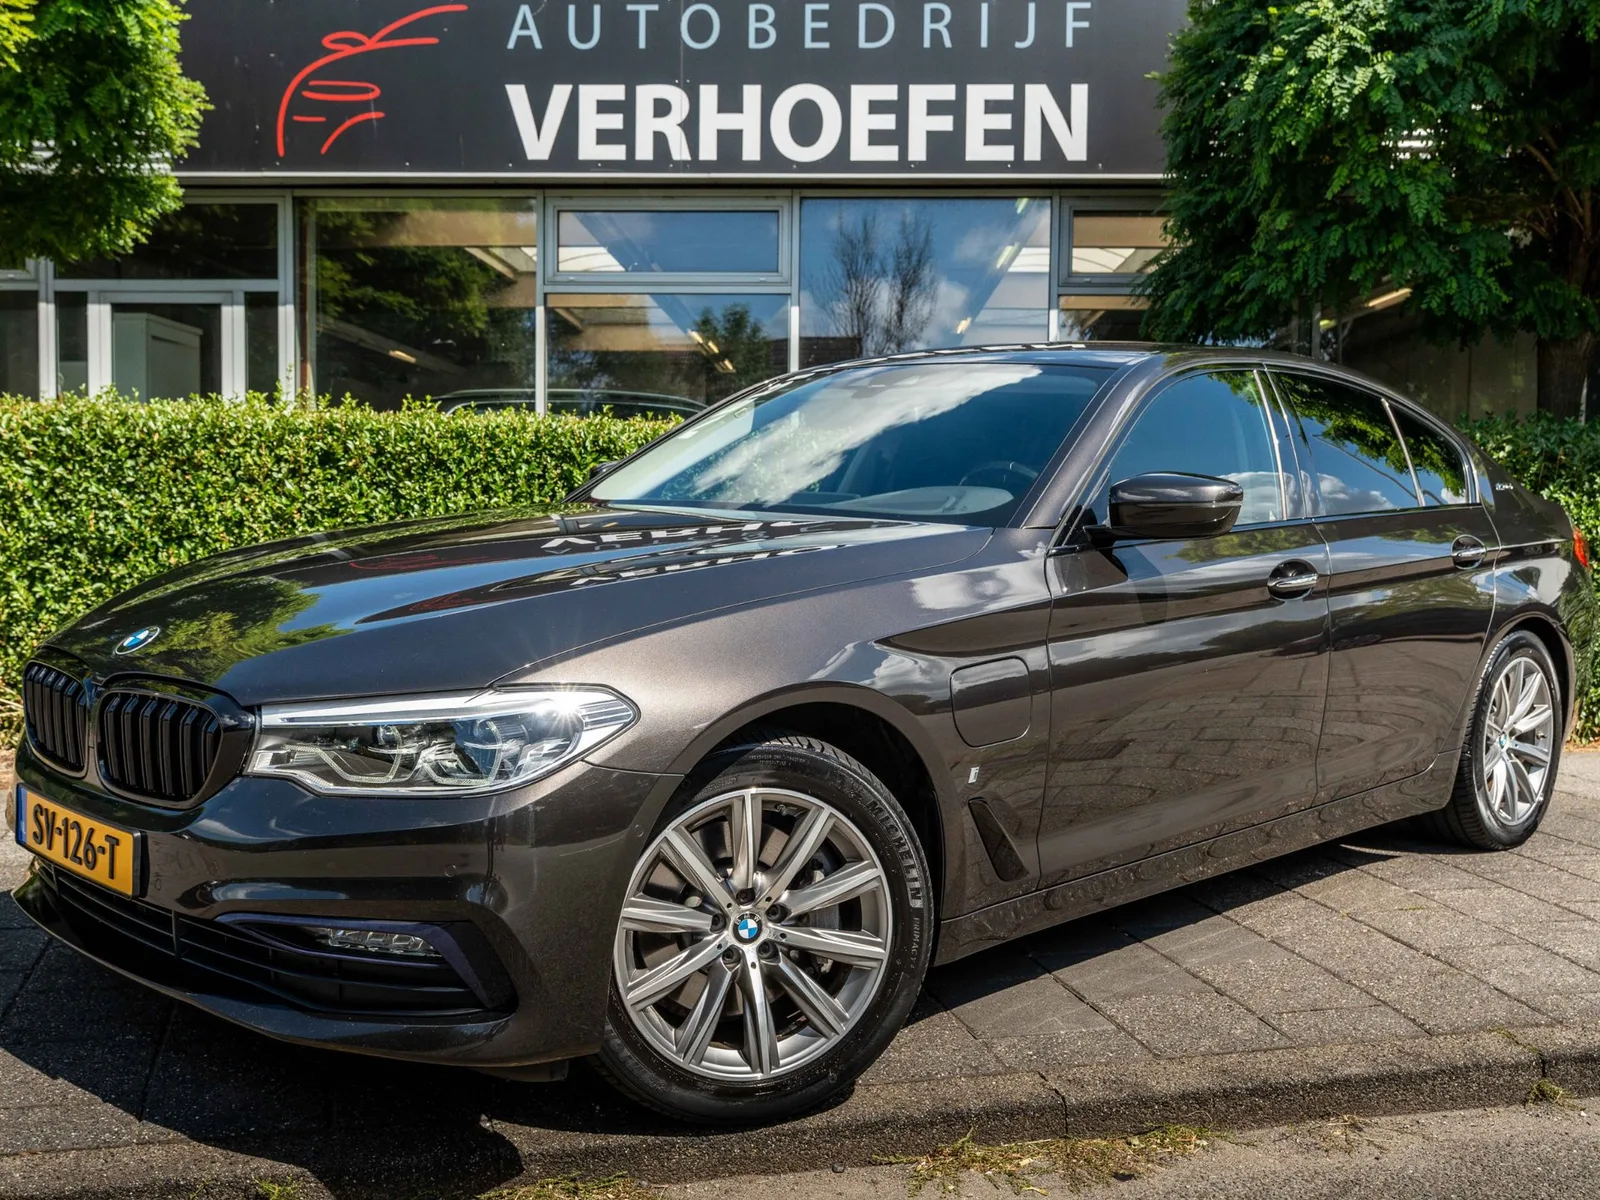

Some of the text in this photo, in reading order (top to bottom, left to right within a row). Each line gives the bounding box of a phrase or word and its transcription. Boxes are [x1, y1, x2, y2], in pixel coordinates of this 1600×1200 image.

[506, 2, 1092, 50] AUTOBEDRIJF
[504, 83, 1089, 162] VERHOEFEN
[32, 803, 121, 880] SV-126-T
[866, 799, 923, 901] MICHELIN
